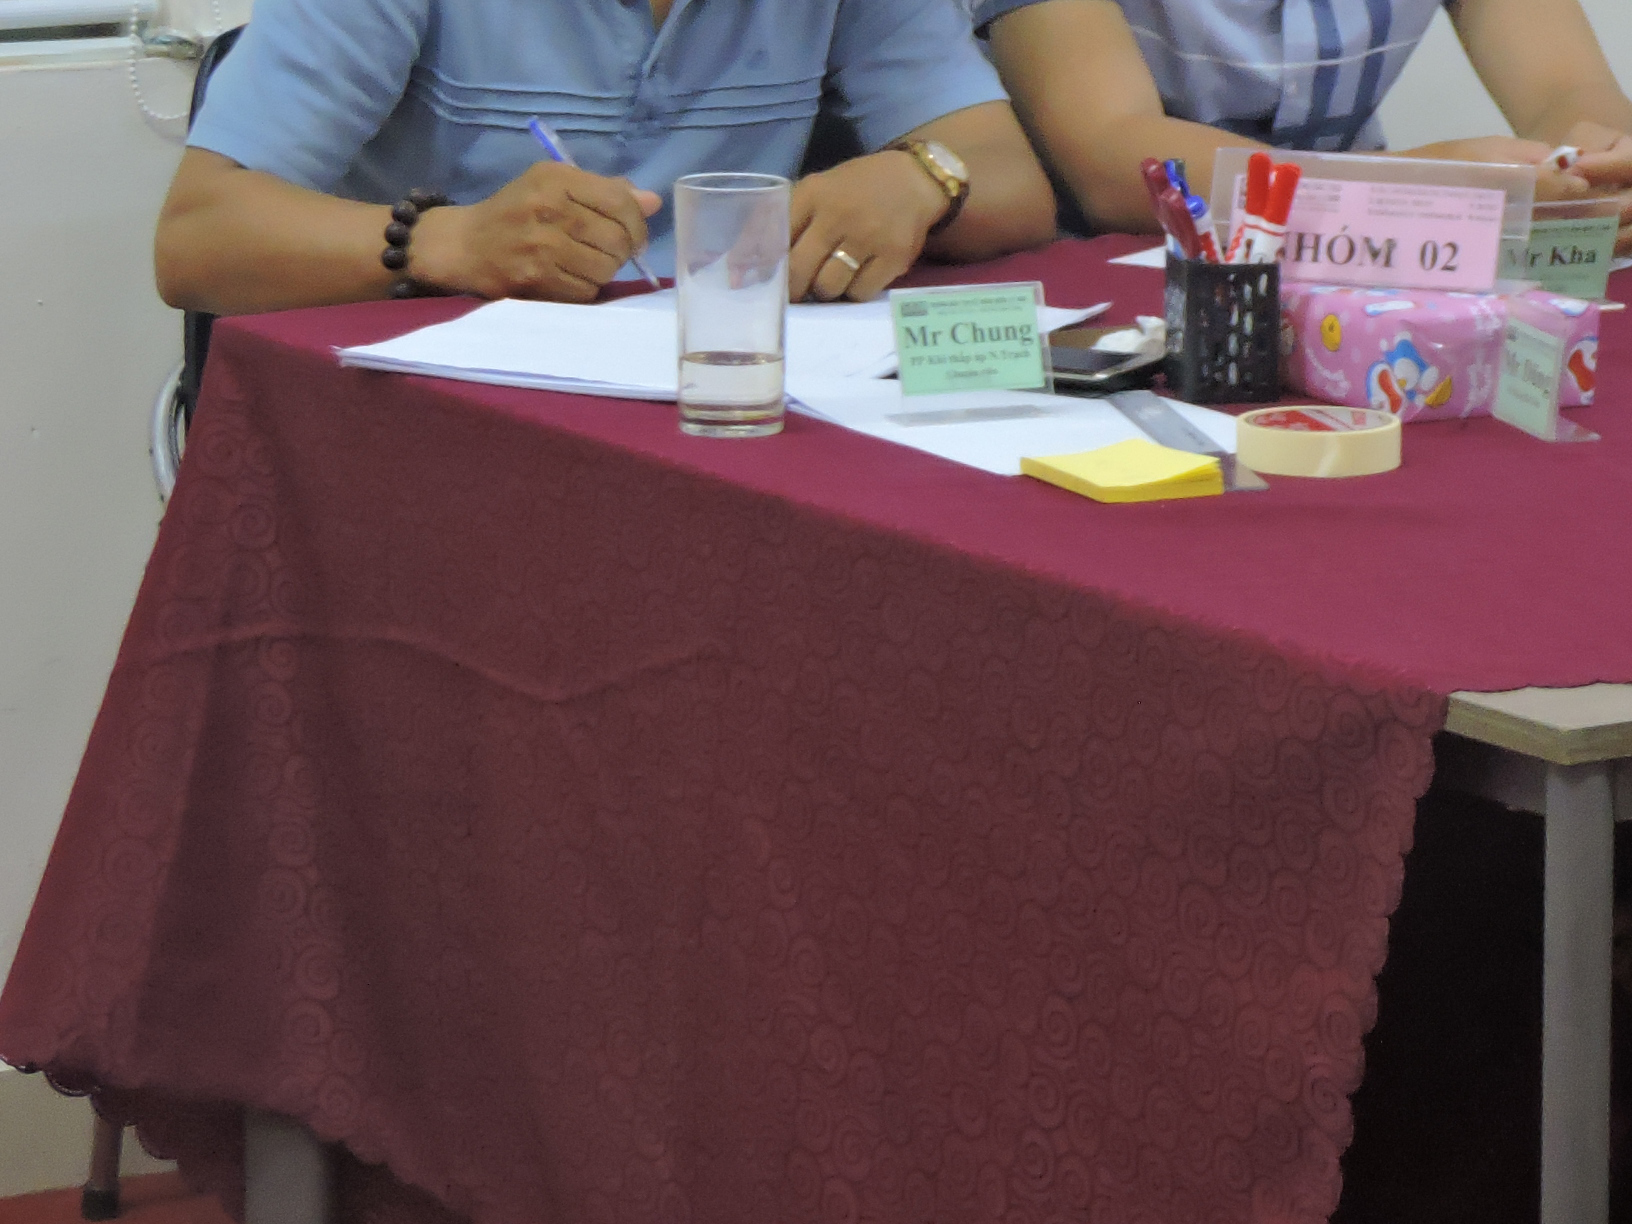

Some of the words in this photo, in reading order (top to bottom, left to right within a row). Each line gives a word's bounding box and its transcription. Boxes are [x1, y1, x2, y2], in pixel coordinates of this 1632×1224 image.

[1419, 240, 1459, 272] 02
[1549, 244, 1597, 267] Kha
[902, 325, 943, 349] Mr
[950, 321, 1034, 347] Chung
